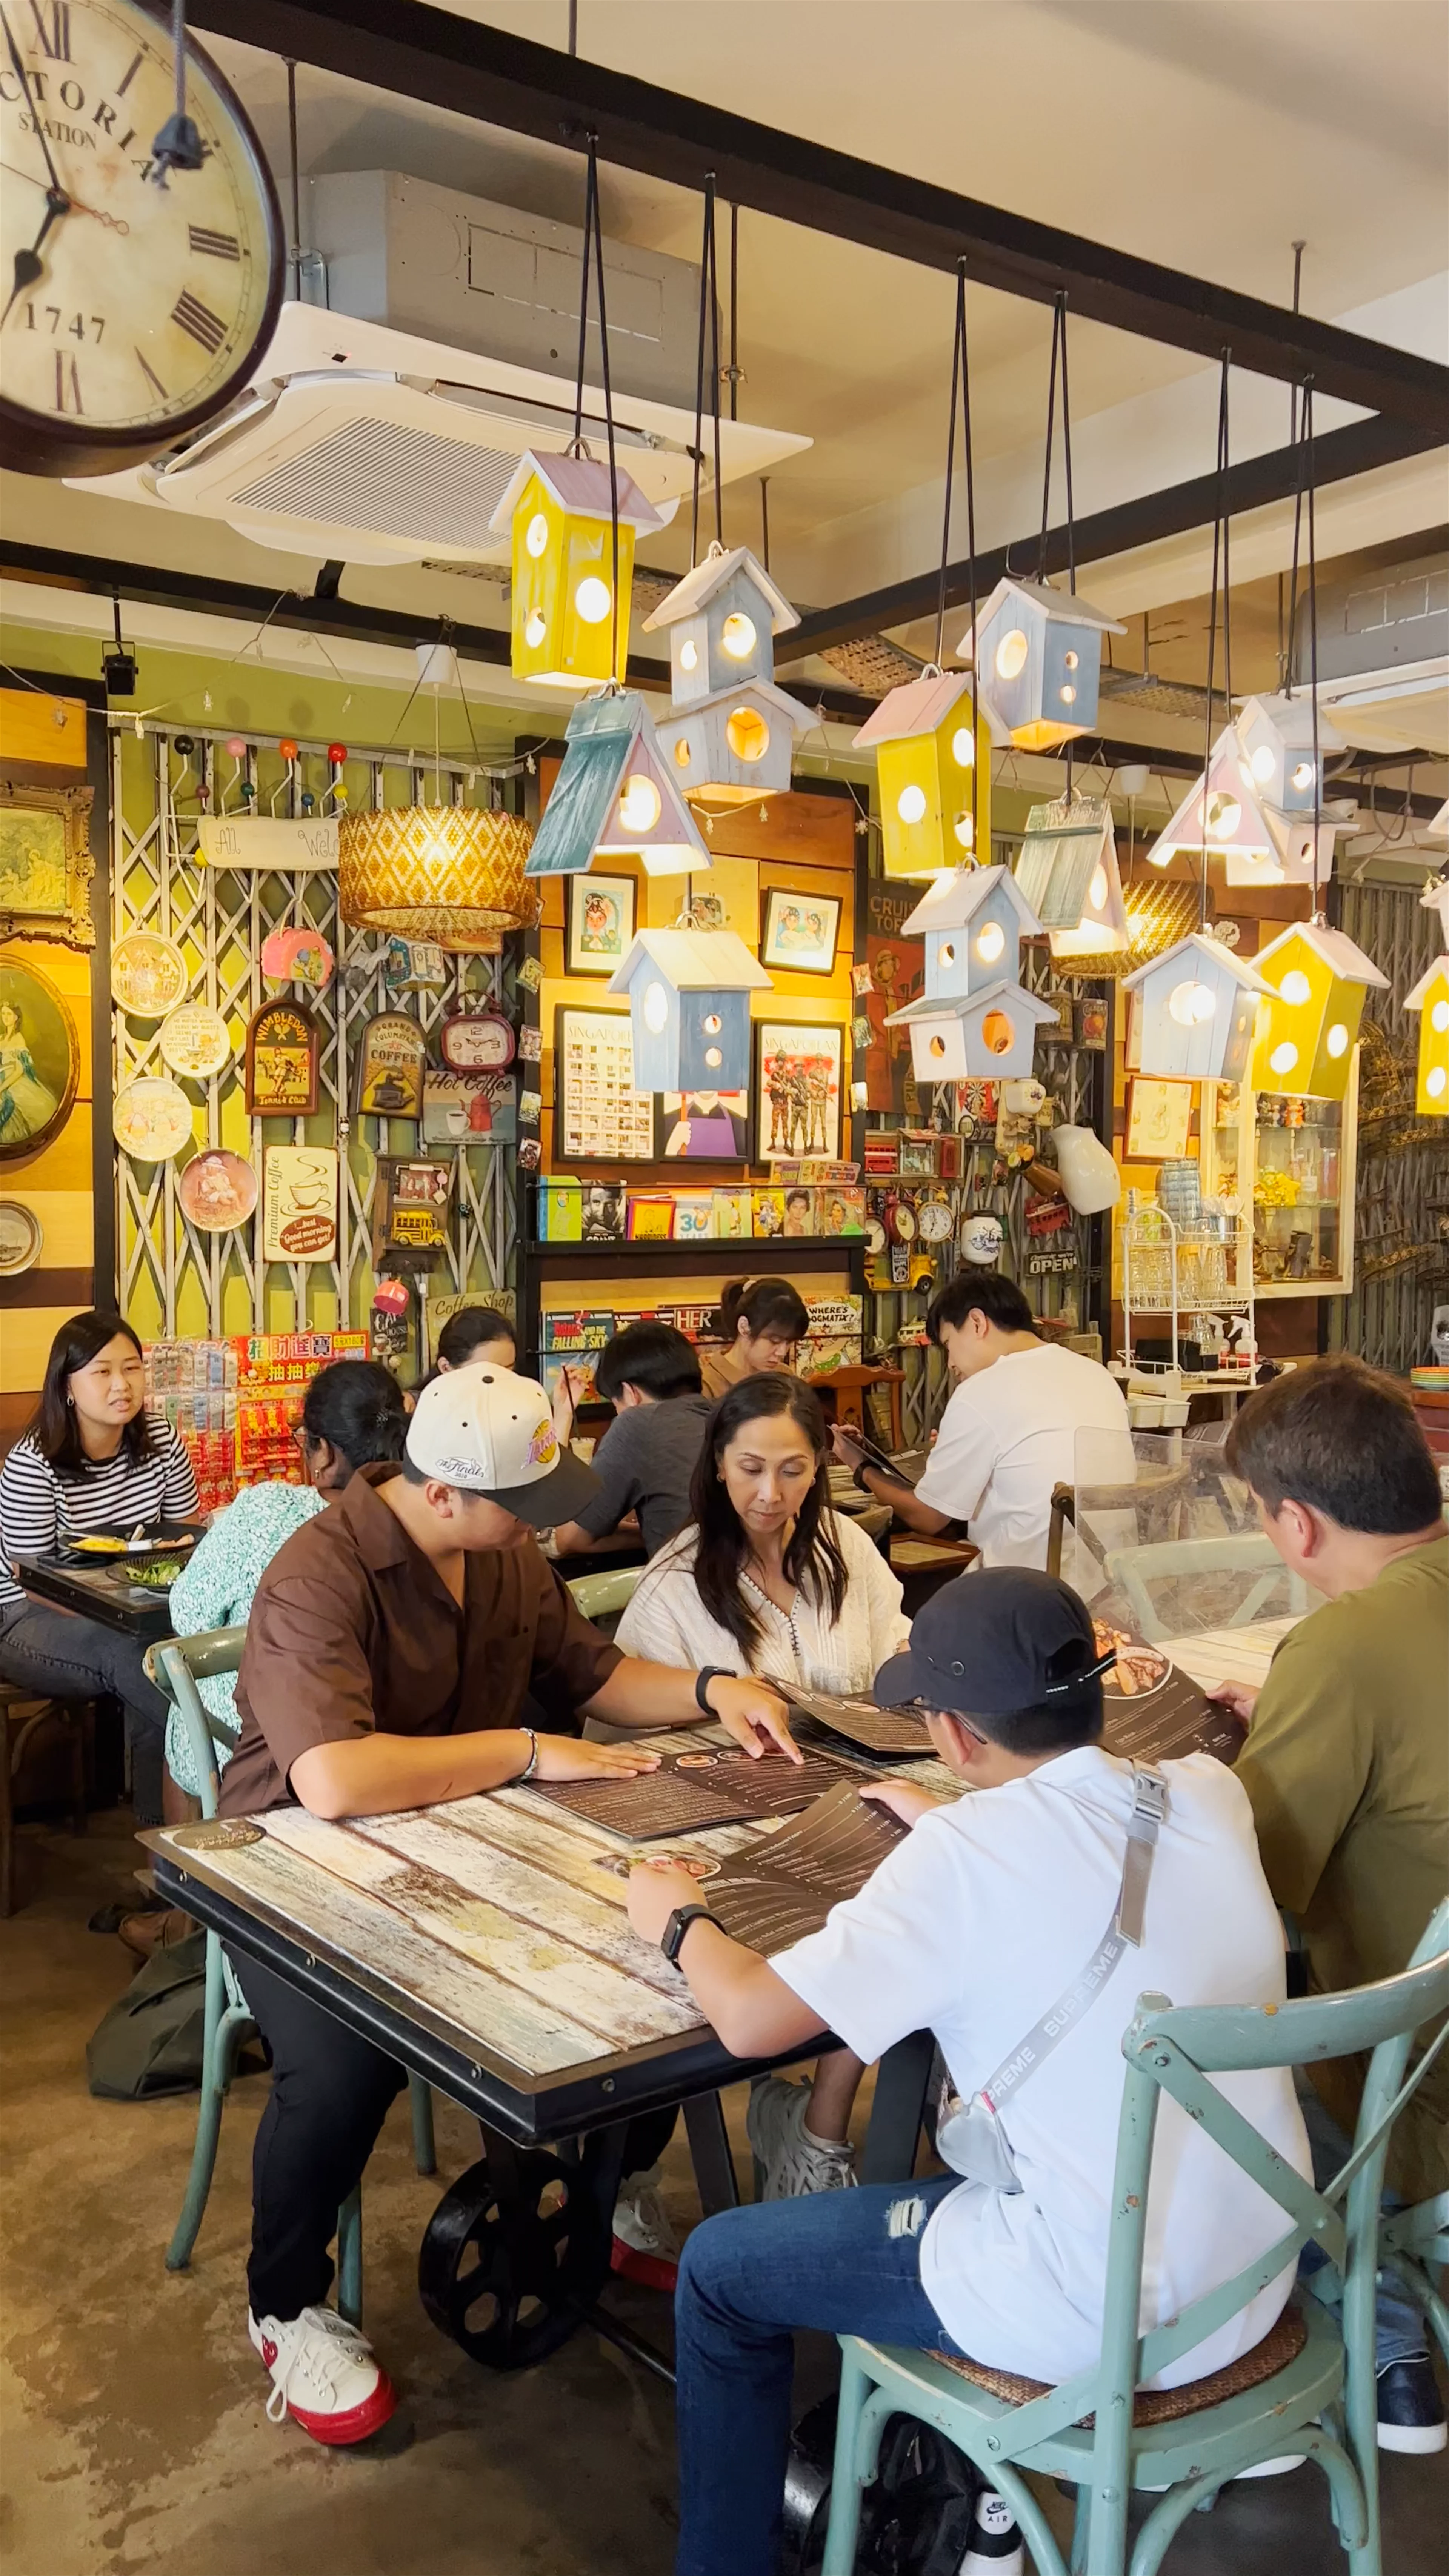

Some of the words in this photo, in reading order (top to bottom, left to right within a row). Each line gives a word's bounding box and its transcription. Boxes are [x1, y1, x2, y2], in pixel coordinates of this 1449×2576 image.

[18, 112, 97, 151] STATION
[27, 302, 105, 344] 1747
[215, 826, 241, 855] All
[256, 1012, 308, 1042] WIMBLEDON
[382, 1022, 411, 1033] GRAND
[470, 1025, 483, 1036] 12
[453, 1041, 462, 1050] 9
[491, 1038, 501, 1050] 3
[371, 1049, 417, 1064] COFFEE
[473, 1055, 483, 1064] 6
[428, 1073, 460, 1089] Hot
[464, 1075, 513, 1100] Coffee
[288, 1095, 306, 1104] Club
[268, 1156, 283, 1191] Coffee
[267, 1193, 280, 1248] Premium
[680, 1213, 708, 1232] 30
[303, 1238, 317, 1247] can
[1030, 1258, 1074, 1274] OPEN
[809, 1306, 848, 1314] WHERE'S
[811, 1313, 854, 1323] OGMATIX?
[552, 1335, 586, 1350] FALLING
[588, 1335, 608, 1348] SKY
[437, 1458, 451, 1469] The
[451, 1457, 485, 1478] Finals
[1044, 1942, 1118, 2037] SUPREME
